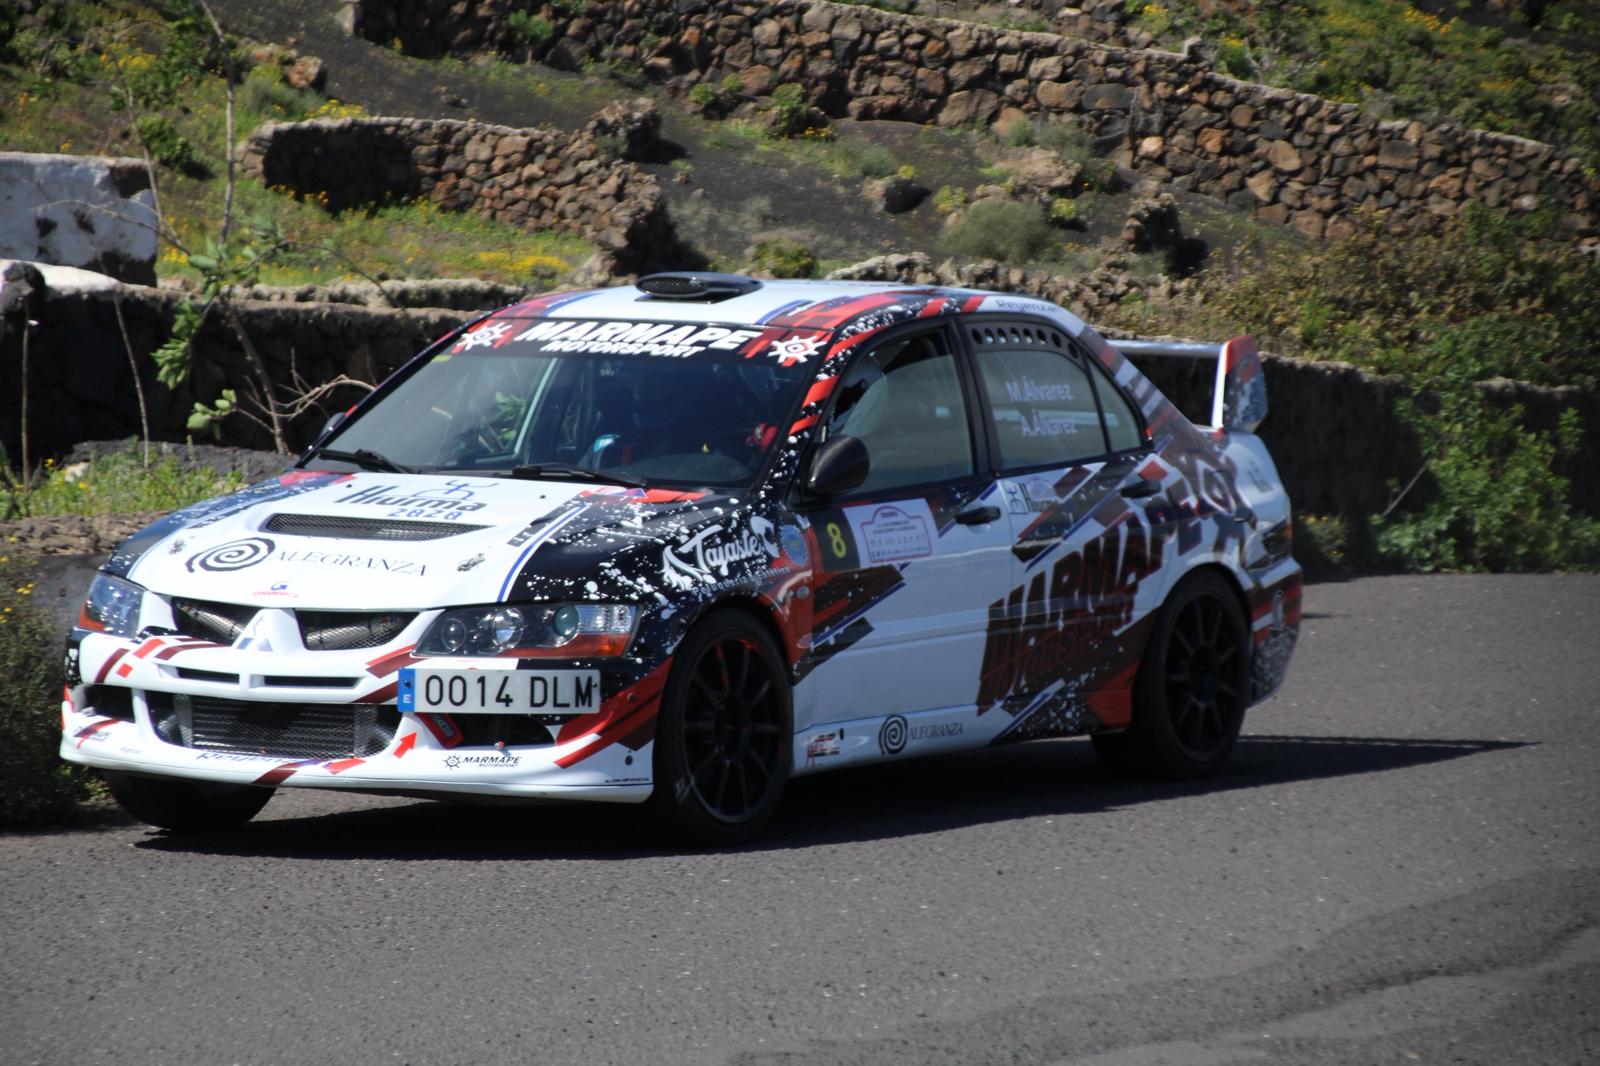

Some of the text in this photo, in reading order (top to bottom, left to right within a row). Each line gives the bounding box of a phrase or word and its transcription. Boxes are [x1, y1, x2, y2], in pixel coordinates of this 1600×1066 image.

[514, 320, 765, 351] MARMAPE
[538, 340, 706, 359] MOTORSPORT
[385, 507, 464, 521] 2020
[826, 521, 847, 559] 8
[270, 550, 427, 577] ALEGRANZA
[402, 693, 413, 704] E
[424, 674, 594, 708] 0014 DLM
[908, 721, 964, 741] ALEGRANZA
[462, 755, 523, 764] MARMAPE
